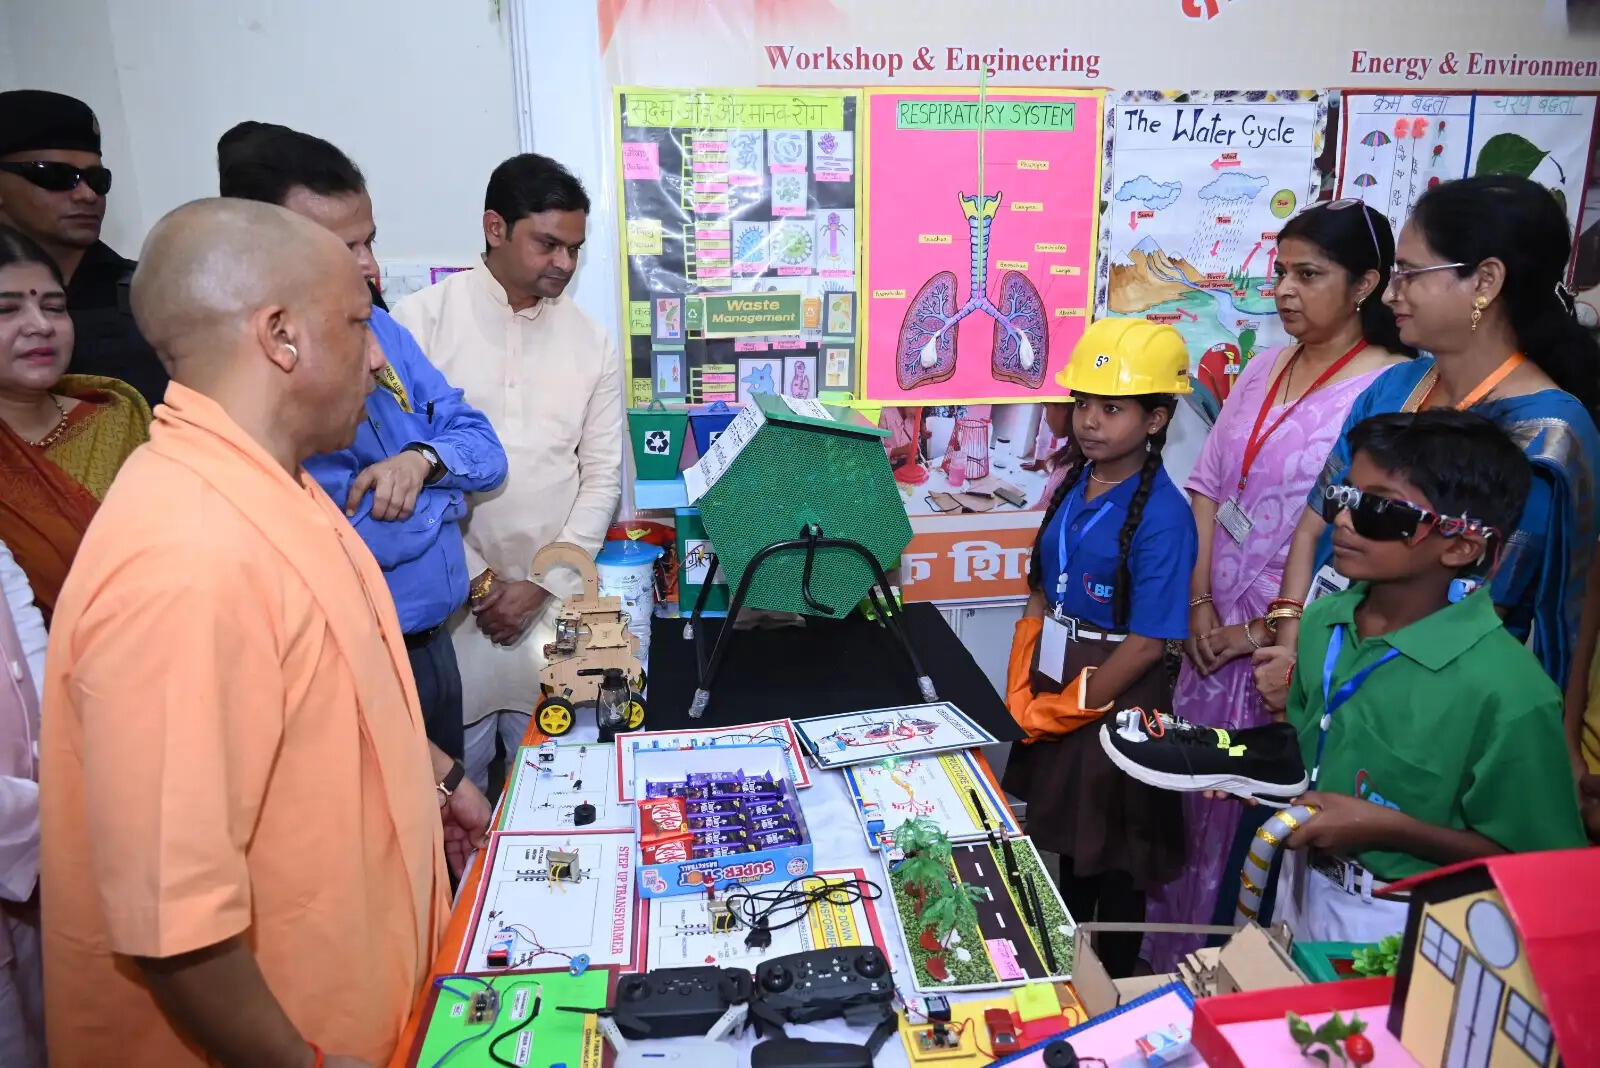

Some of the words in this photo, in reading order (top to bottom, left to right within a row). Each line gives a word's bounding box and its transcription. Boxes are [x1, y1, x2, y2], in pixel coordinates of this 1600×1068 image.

[764, 44, 902, 77] Workshop
[912, 46, 936, 72] &
[946, 47, 1101, 79] Engineering
[1350, 50, 1432, 80] Energy
[1438, 51, 1460, 75] &
[1466, 52, 1600, 77] Environmen
[1010, 103, 1075, 127] SYSTEM
[1124, 108, 1162, 133] The
[1172, 108, 1237, 146] Water
[1241, 114, 1295, 149] Cycle
[727, 299, 780, 312] Waste
[711, 312, 796, 324] Management
[618, 846, 630, 869] STEP
[617, 871, 628, 882] UP
[724, 861, 775, 879] SUPER
[611, 883, 627, 955] TRANSFORMER
[838, 915, 853, 941] DOWN
